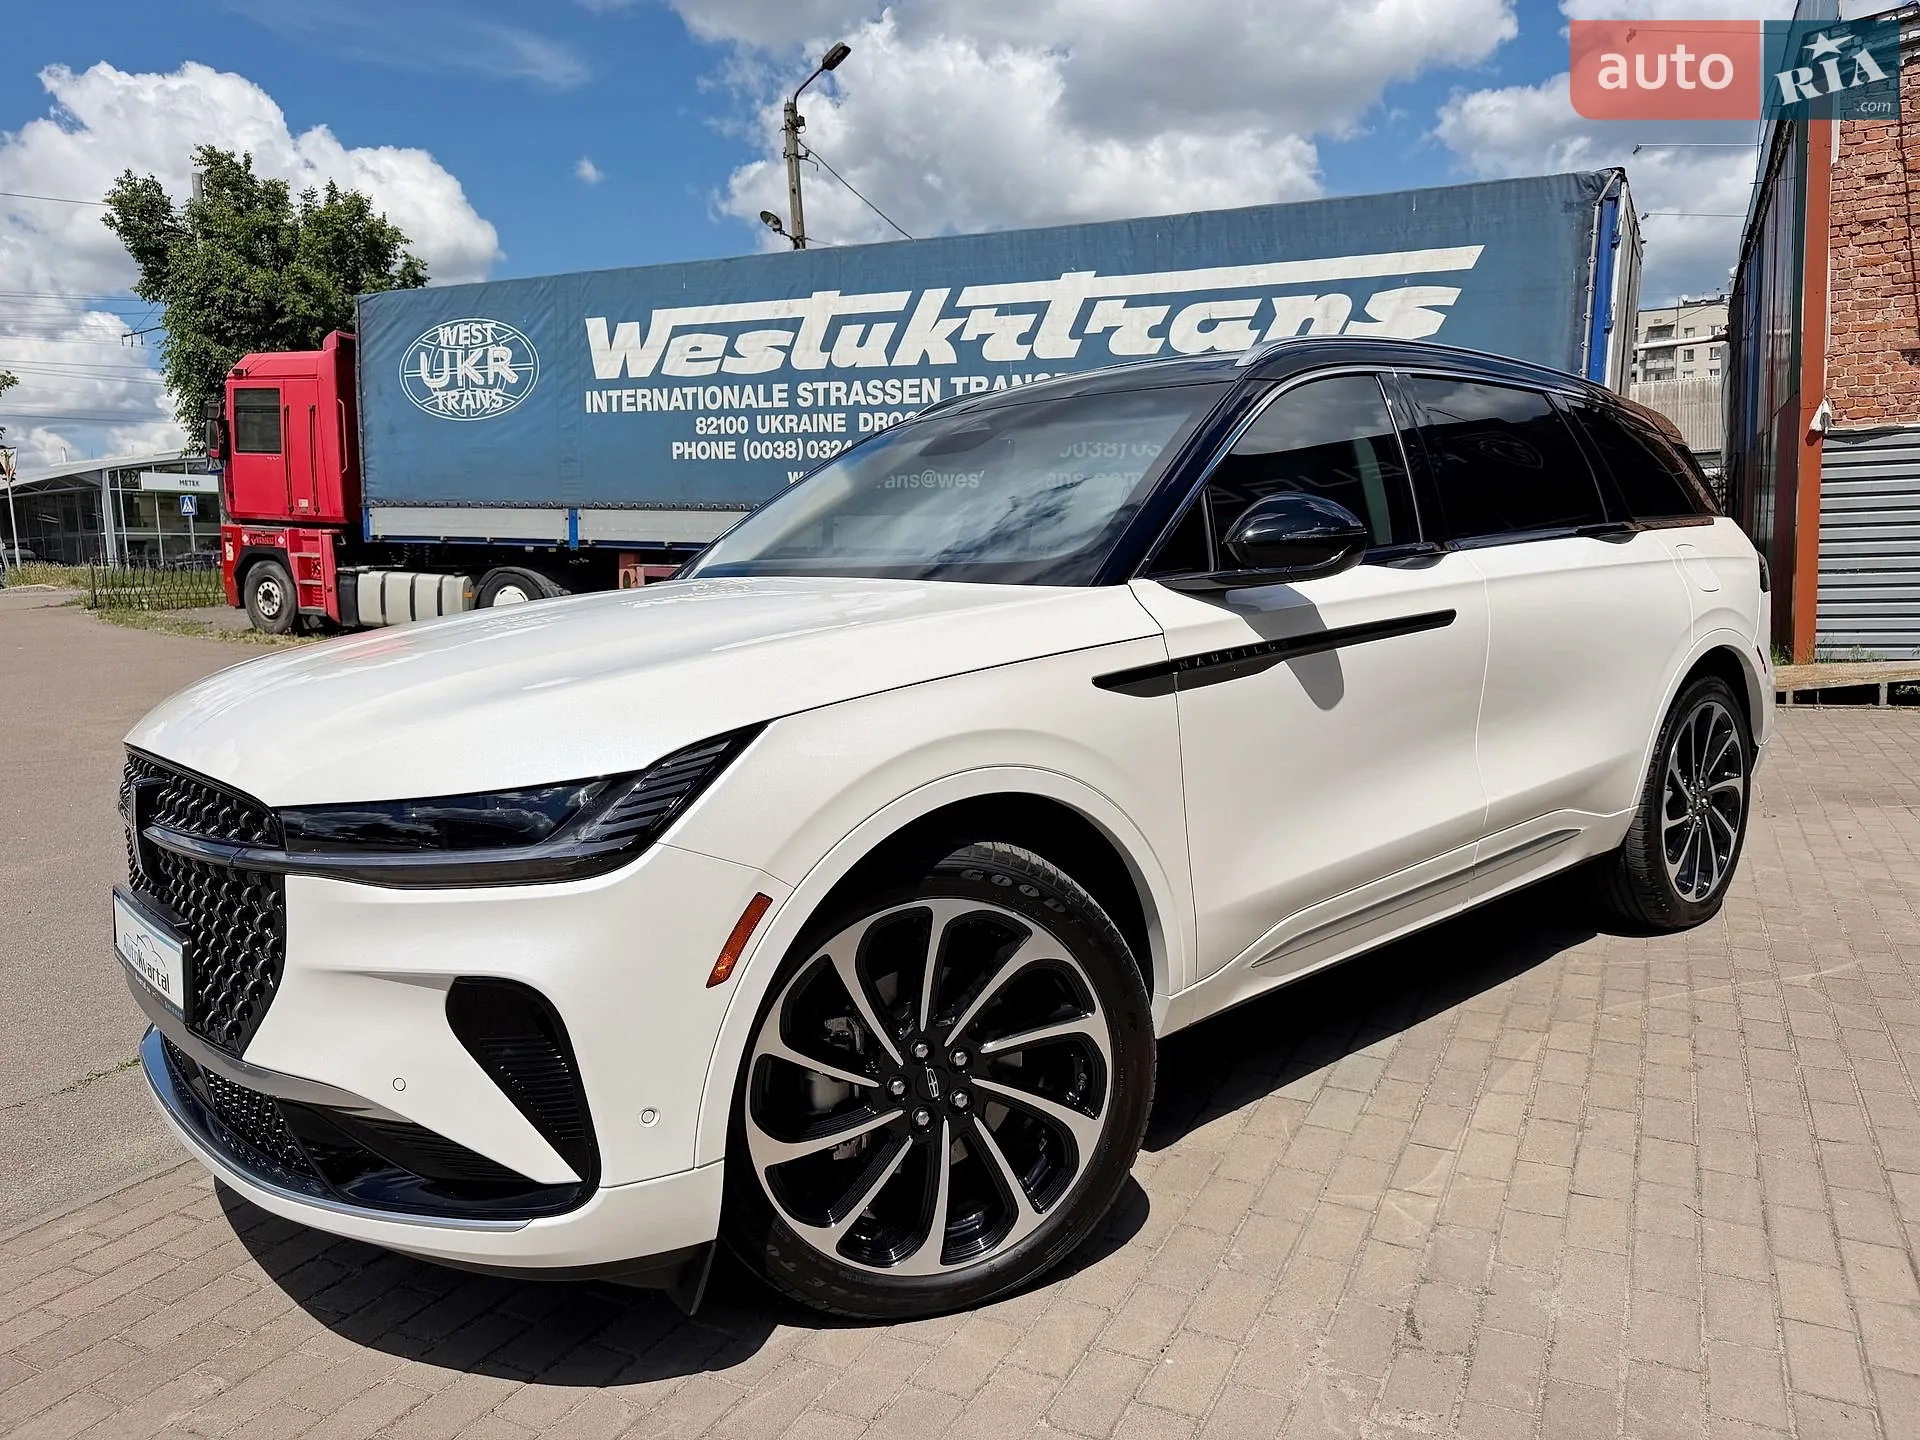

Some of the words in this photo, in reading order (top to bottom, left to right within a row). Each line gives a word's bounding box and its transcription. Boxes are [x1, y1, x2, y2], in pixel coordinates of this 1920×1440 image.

[437, 322, 496, 347] WEST
[419, 346, 519, 388] UKR
[436, 389, 503, 411] TRANS
[585, 382, 789, 413] INTERNATIONALE
[797, 377, 941, 407] STRASSEN
[695, 416, 749, 435] 82100
[757, 413, 847, 433] UKRAINE
[672, 441, 737, 460] PHONE
